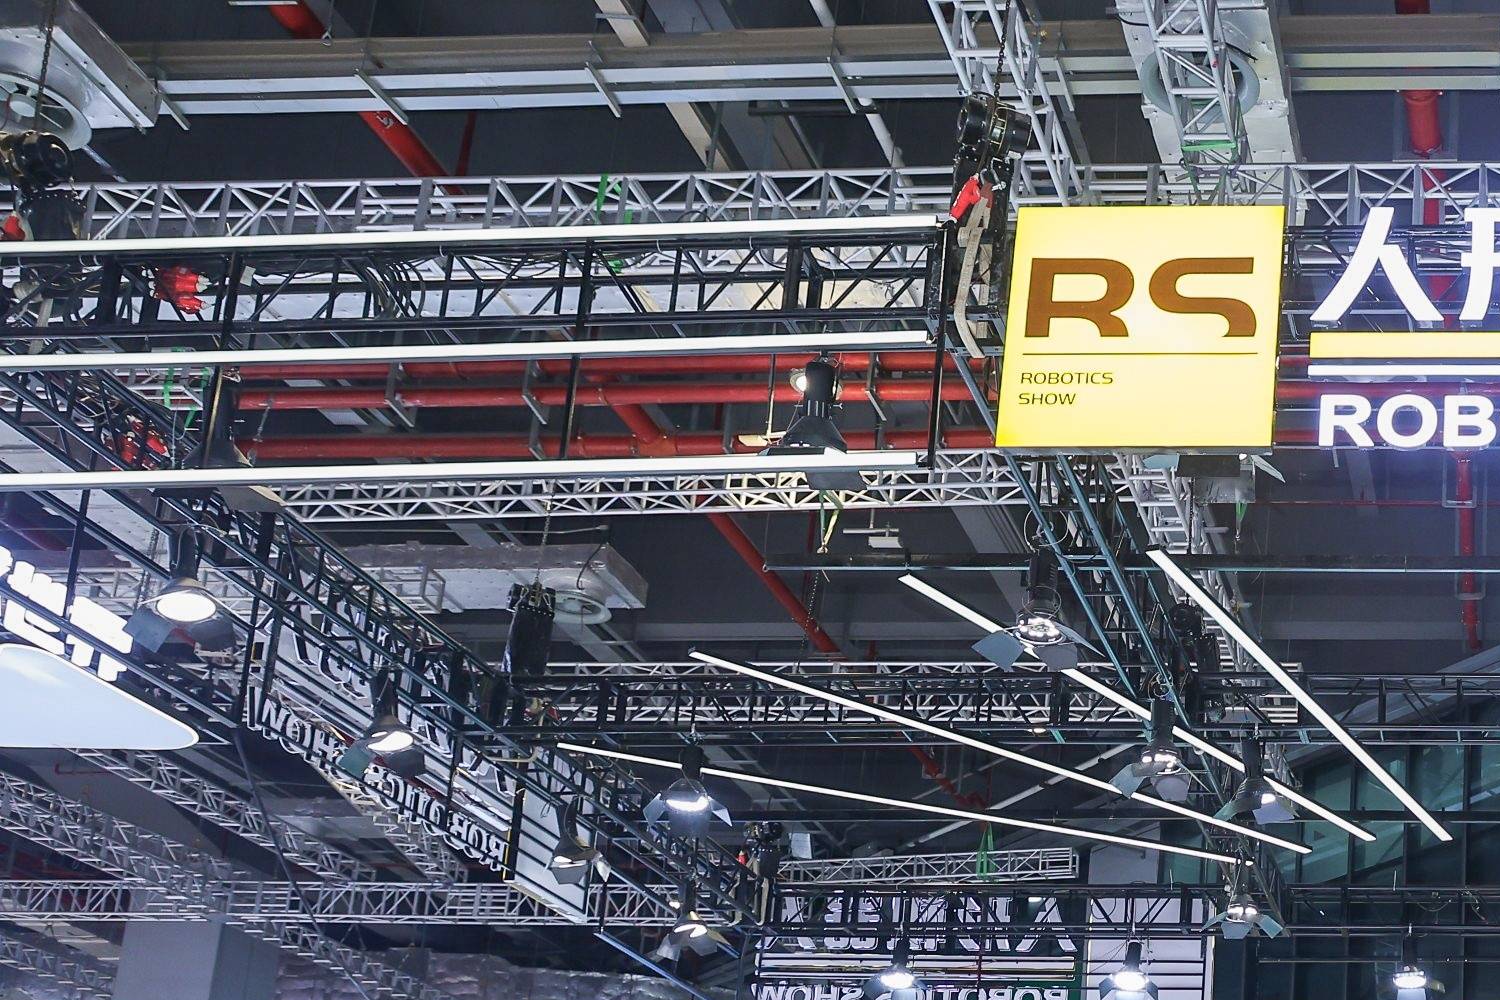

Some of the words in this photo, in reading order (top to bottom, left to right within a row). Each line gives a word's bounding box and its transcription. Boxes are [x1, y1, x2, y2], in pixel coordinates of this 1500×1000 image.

[1024, 257, 1258, 338] RS
[1020, 372, 1114, 385] ROBOTICS
[1018, 392, 1077, 405] SHOW
